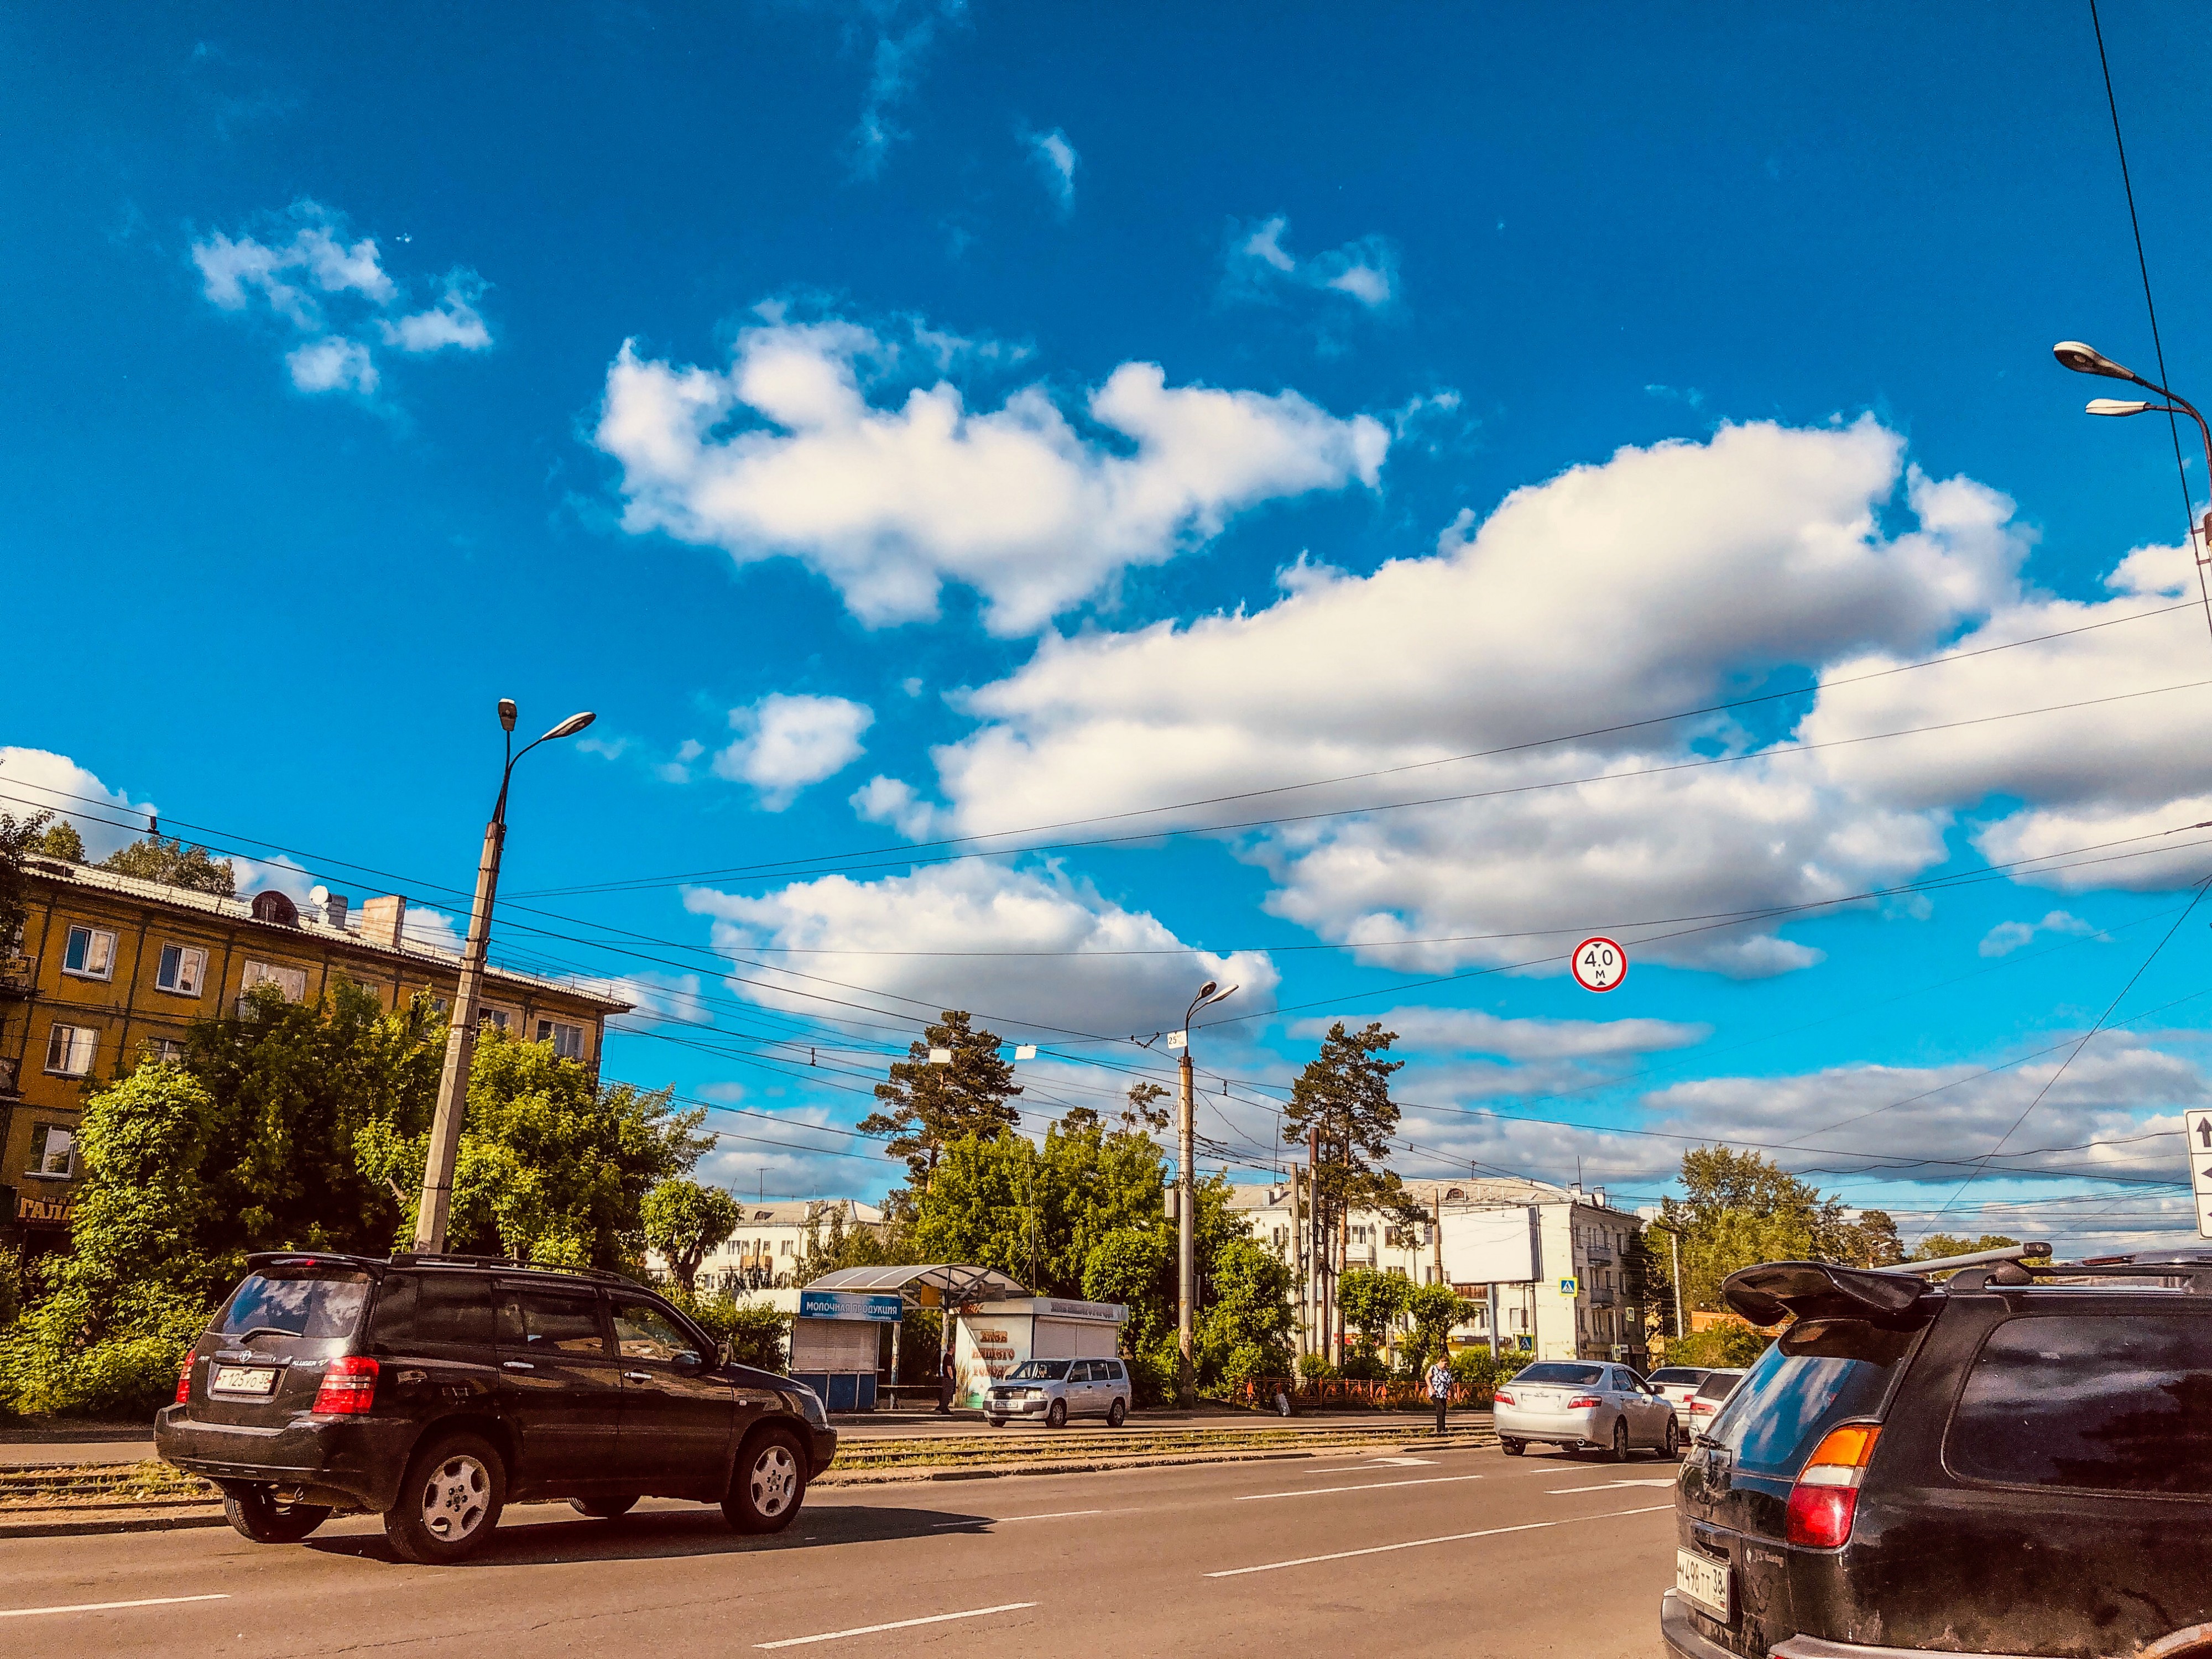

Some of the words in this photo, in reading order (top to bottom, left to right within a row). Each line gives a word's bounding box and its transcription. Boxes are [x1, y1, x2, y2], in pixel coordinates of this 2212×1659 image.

[1168, 1036, 1177, 1045] 25
[806, 1301, 850, 1313] МОЛОЧНАЯ
[852, 1303, 898, 1315] ПРОДУКЦИЯ
[980, 1331, 1008, 1343] ХЛЕБ
[972, 1348, 1015, 1360] НАШЕГО
